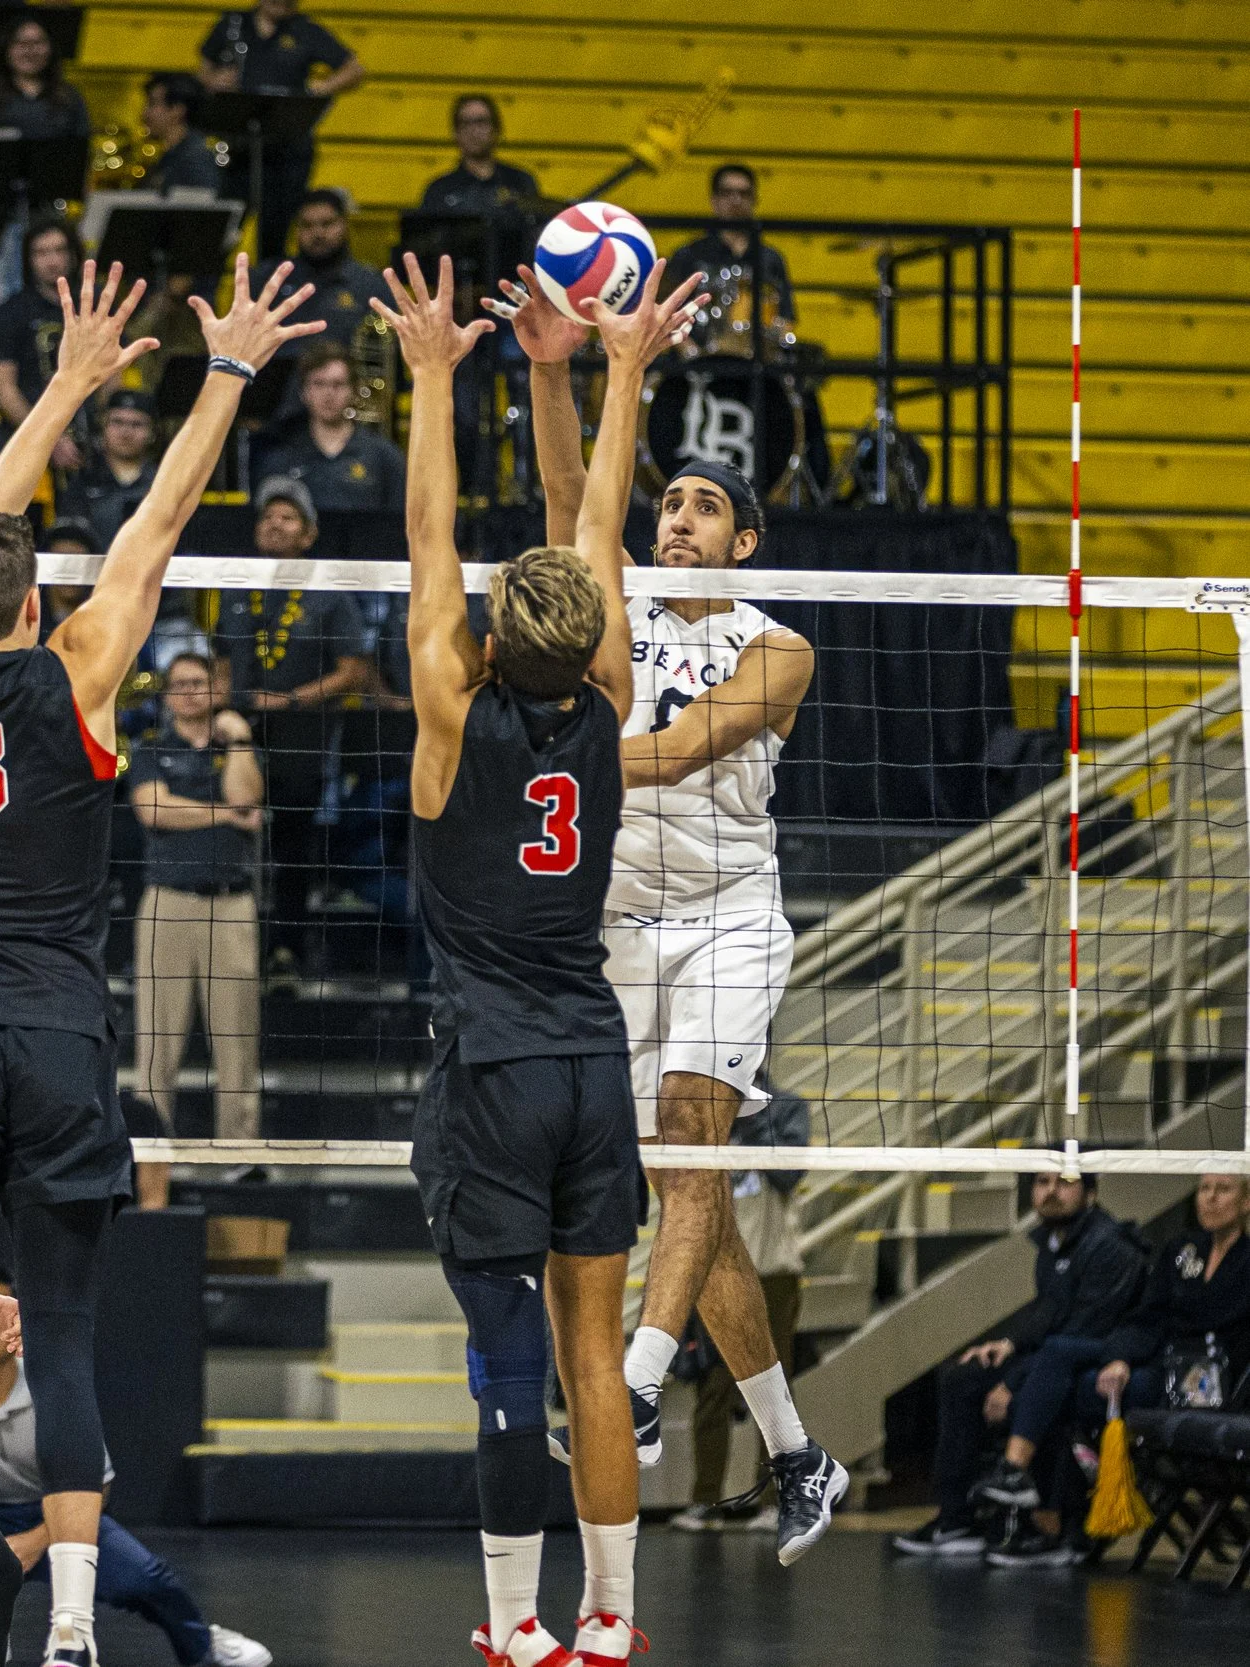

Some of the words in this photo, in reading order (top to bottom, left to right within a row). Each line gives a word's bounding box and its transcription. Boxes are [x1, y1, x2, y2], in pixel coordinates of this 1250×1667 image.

[603, 266, 636, 306] NCAA
[1213, 584, 1250, 593] Senoh
[518, 772, 580, 875] 3
